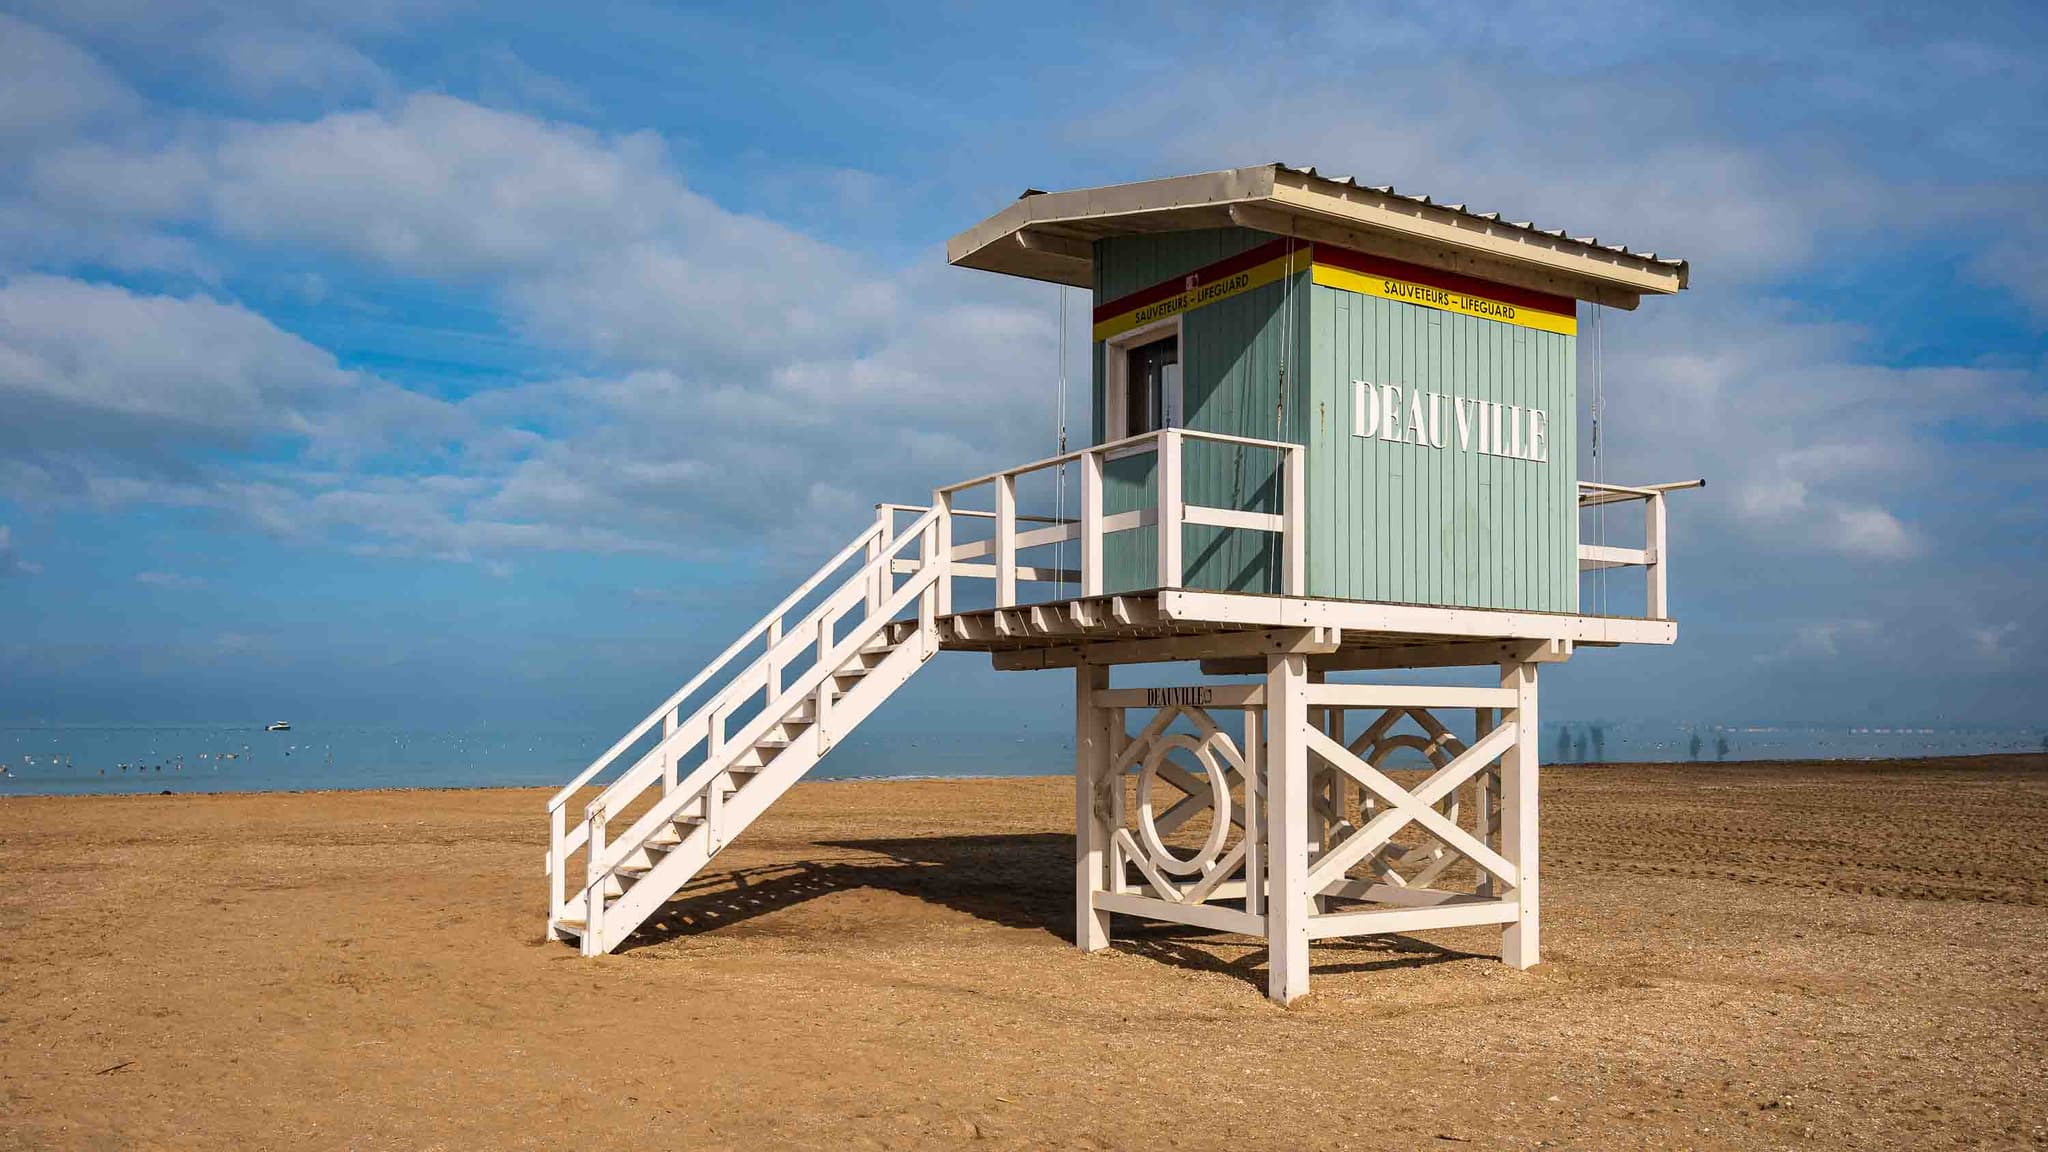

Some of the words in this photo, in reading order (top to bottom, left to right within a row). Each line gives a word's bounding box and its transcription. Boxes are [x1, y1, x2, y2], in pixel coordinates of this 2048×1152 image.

[1135, 296, 1188, 323] SAUVETEURS
[1197, 274, 1249, 303] LIFEGUARD
[1384, 281, 1449, 306] SAUVETEURS
[1461, 296, 1515, 319] LIFEGUARD
[1352, 380, 1547, 463] DEAUVILLE
[1147, 687, 1204, 706] DEAUVILLE
